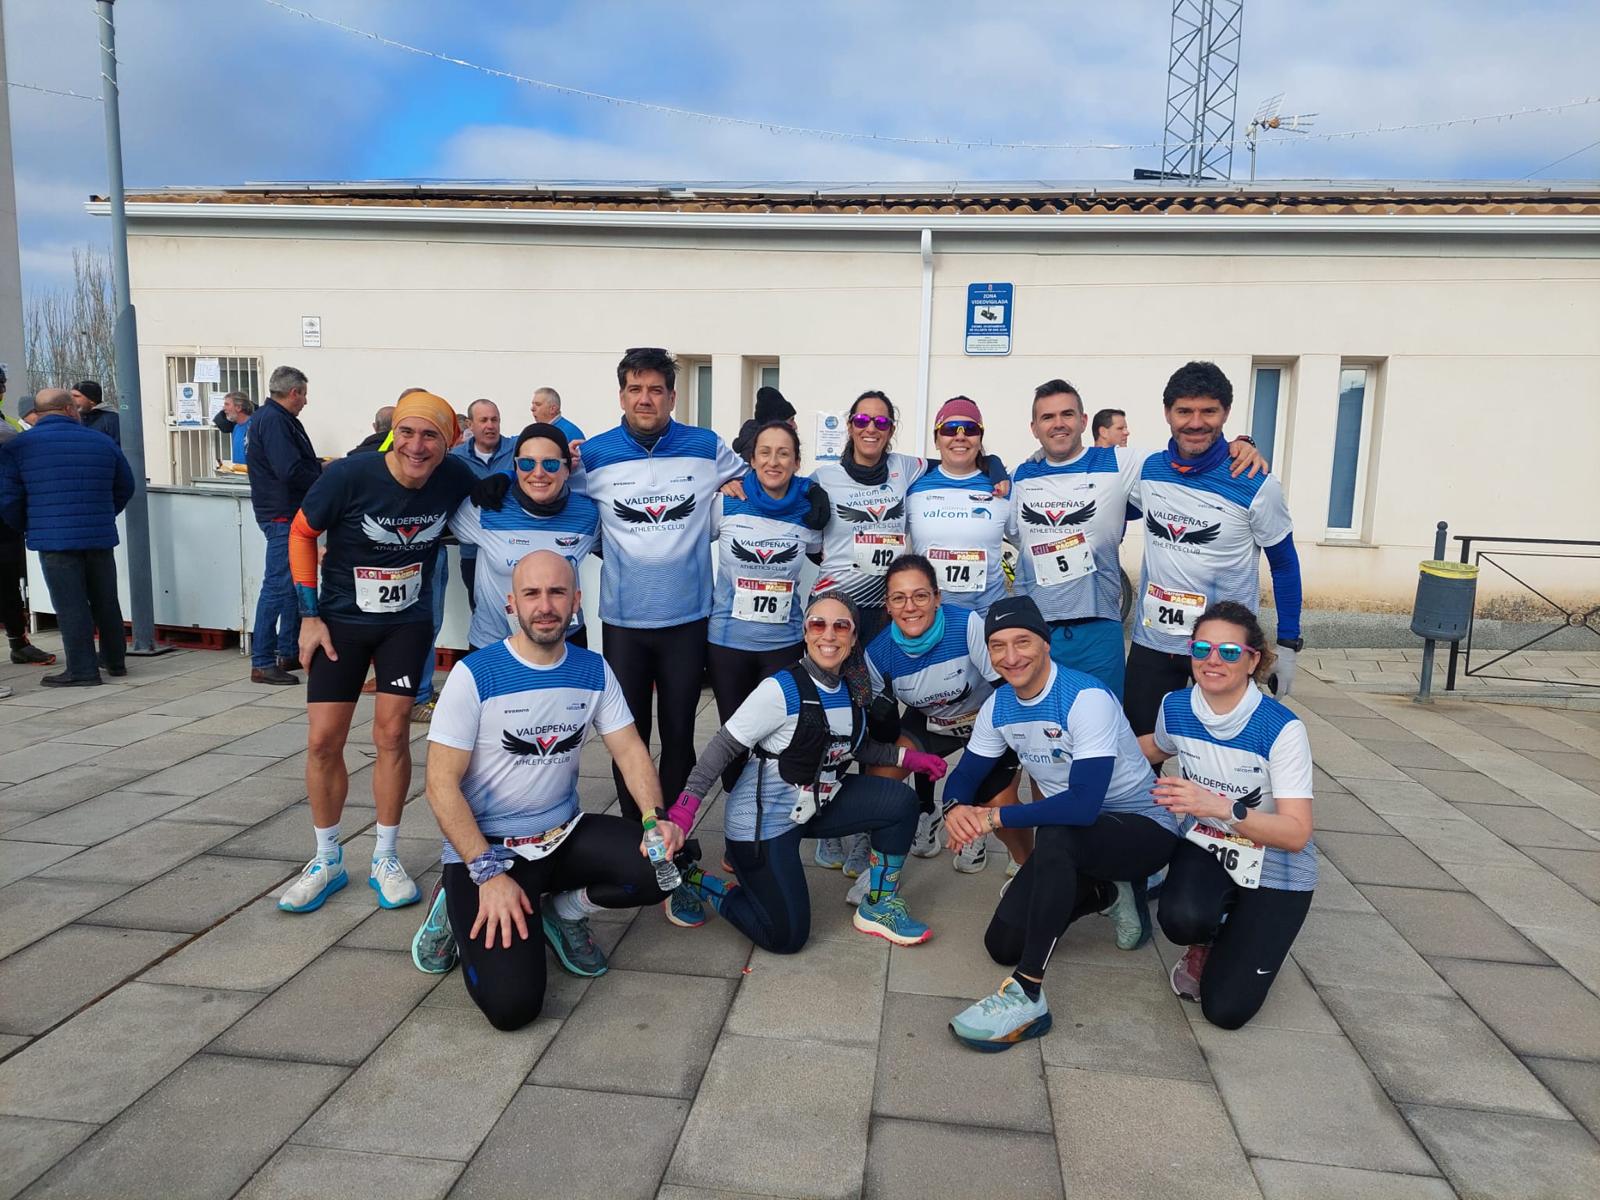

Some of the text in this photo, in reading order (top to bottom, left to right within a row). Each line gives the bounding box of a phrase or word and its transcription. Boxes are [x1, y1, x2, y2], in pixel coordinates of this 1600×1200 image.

[625, 492, 686, 506] VALDEPEÑAS
[849, 488, 880, 498] valcom
[846, 495, 901, 507] VALDEPEÑAS
[1030, 500, 1086, 509] VALDEPEÑAS
[376, 513, 440, 527] VALDEPEÑAS
[923, 509, 969, 519] valcom
[1153, 509, 1209, 529] VALDEPEÑAS
[629, 523, 686, 534] ATHLETICS CLUB
[740, 539, 791, 549] VALDEPEÑAS
[1151, 540, 1182, 552] ATHLETICS
[871, 549, 894, 567] 412
[930, 550, 949, 559] XIII
[1055, 555, 1069, 573] 5
[945, 565, 970, 583] 174
[378, 583, 407, 604] 241
[753, 595, 778, 614] 176
[1158, 605, 1185, 626] 214
[909, 687, 962, 706] VALDEPEÑAS
[515, 722, 578, 737] VALDEPEÑAS
[514, 755, 571, 767] ATHLETICS CLUB
[1188, 770, 1249, 795] VALDEPEÑAS
